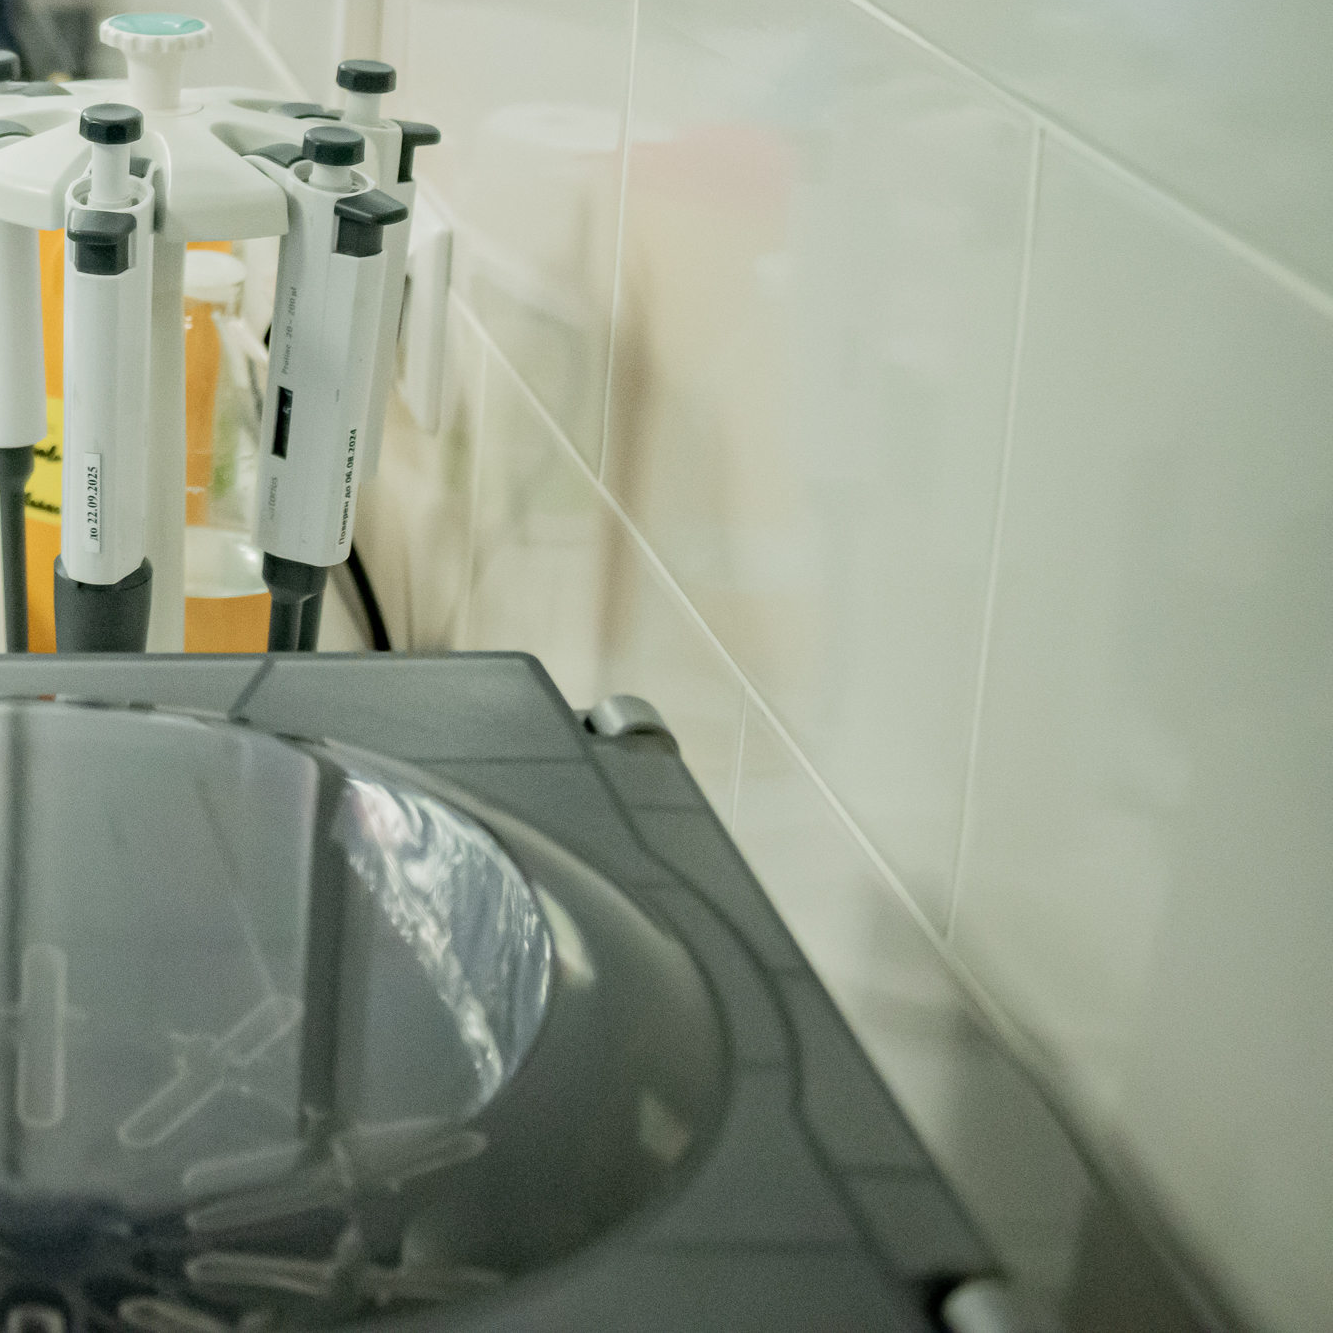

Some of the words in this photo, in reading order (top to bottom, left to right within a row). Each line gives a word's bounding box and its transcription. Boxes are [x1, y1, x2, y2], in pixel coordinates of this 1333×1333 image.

[345, 428, 357, 484] 06.08.2024
[87, 466, 98, 525] 22.09.2025
[345, 485, 351, 499] до
[89, 527, 99, 542] до
[338, 500, 349, 545] Поверен
